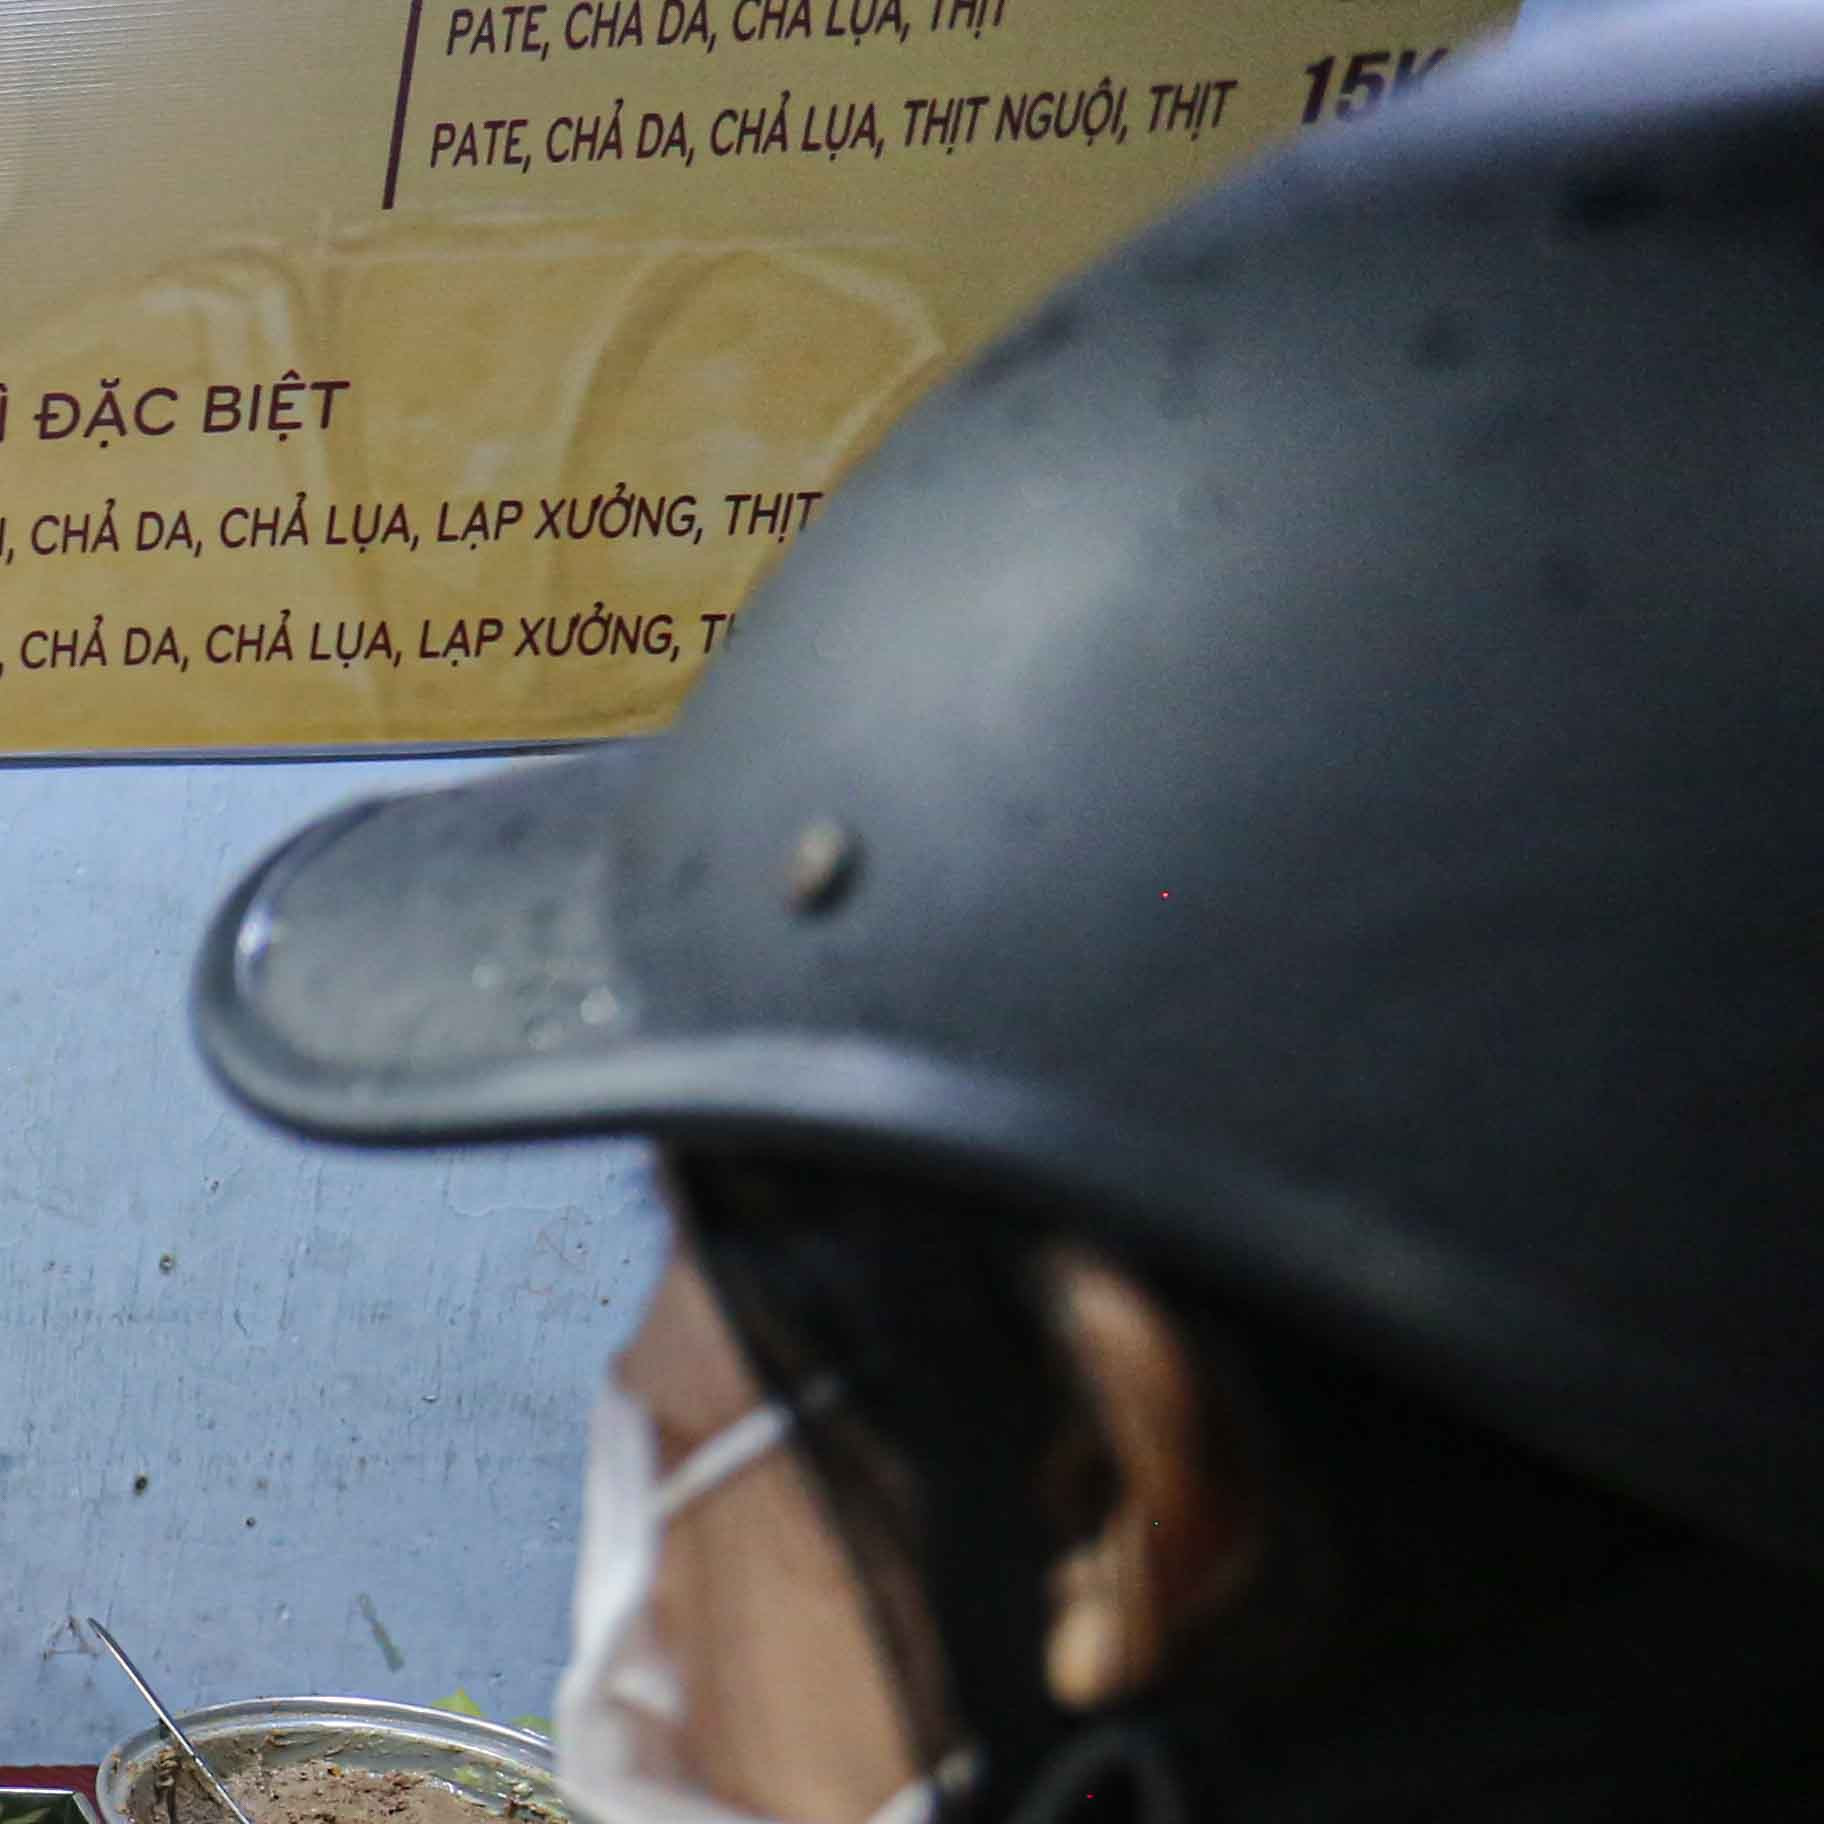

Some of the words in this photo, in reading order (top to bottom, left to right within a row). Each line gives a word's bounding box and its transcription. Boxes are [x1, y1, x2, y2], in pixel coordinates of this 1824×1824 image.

[446, 4, 550, 62] PATE,
[656, 0, 717, 54] DA,
[430, 119, 531, 174] PATE,
[546, 97, 625, 163] CHẢ
[635, 111, 695, 168] DA,
[710, 89, 791, 157] CHẢ
[801, 102, 885, 161] LỤA,
[903, 95, 991, 155] THỊT
[994, 75, 1128, 147] NGUỘI,
[1148, 79, 1239, 142] THỊT
[33, 377, 179, 449] ĐẶC
[202, 369, 351, 442] BIỆT
[31, 497, 120, 556] CHẢ
[135, 510, 203, 558] DA,
[220, 491, 309, 549] CHẢ
[325, 503, 419, 554] LỤA,
[436, 500, 524, 551] LẠP
[533, 481, 703, 545] XƯỞNG,
[724, 491, 825, 544] THỊT
[20, 613, 108, 670] CHẢ
[123, 626, 189, 673] DA,
[205, 608, 294, 664] CHẢ
[309, 620, 402, 669] LỤA,
[419, 617, 504, 667] LẠP
[513, 601, 680, 663] XƯỞNG,
